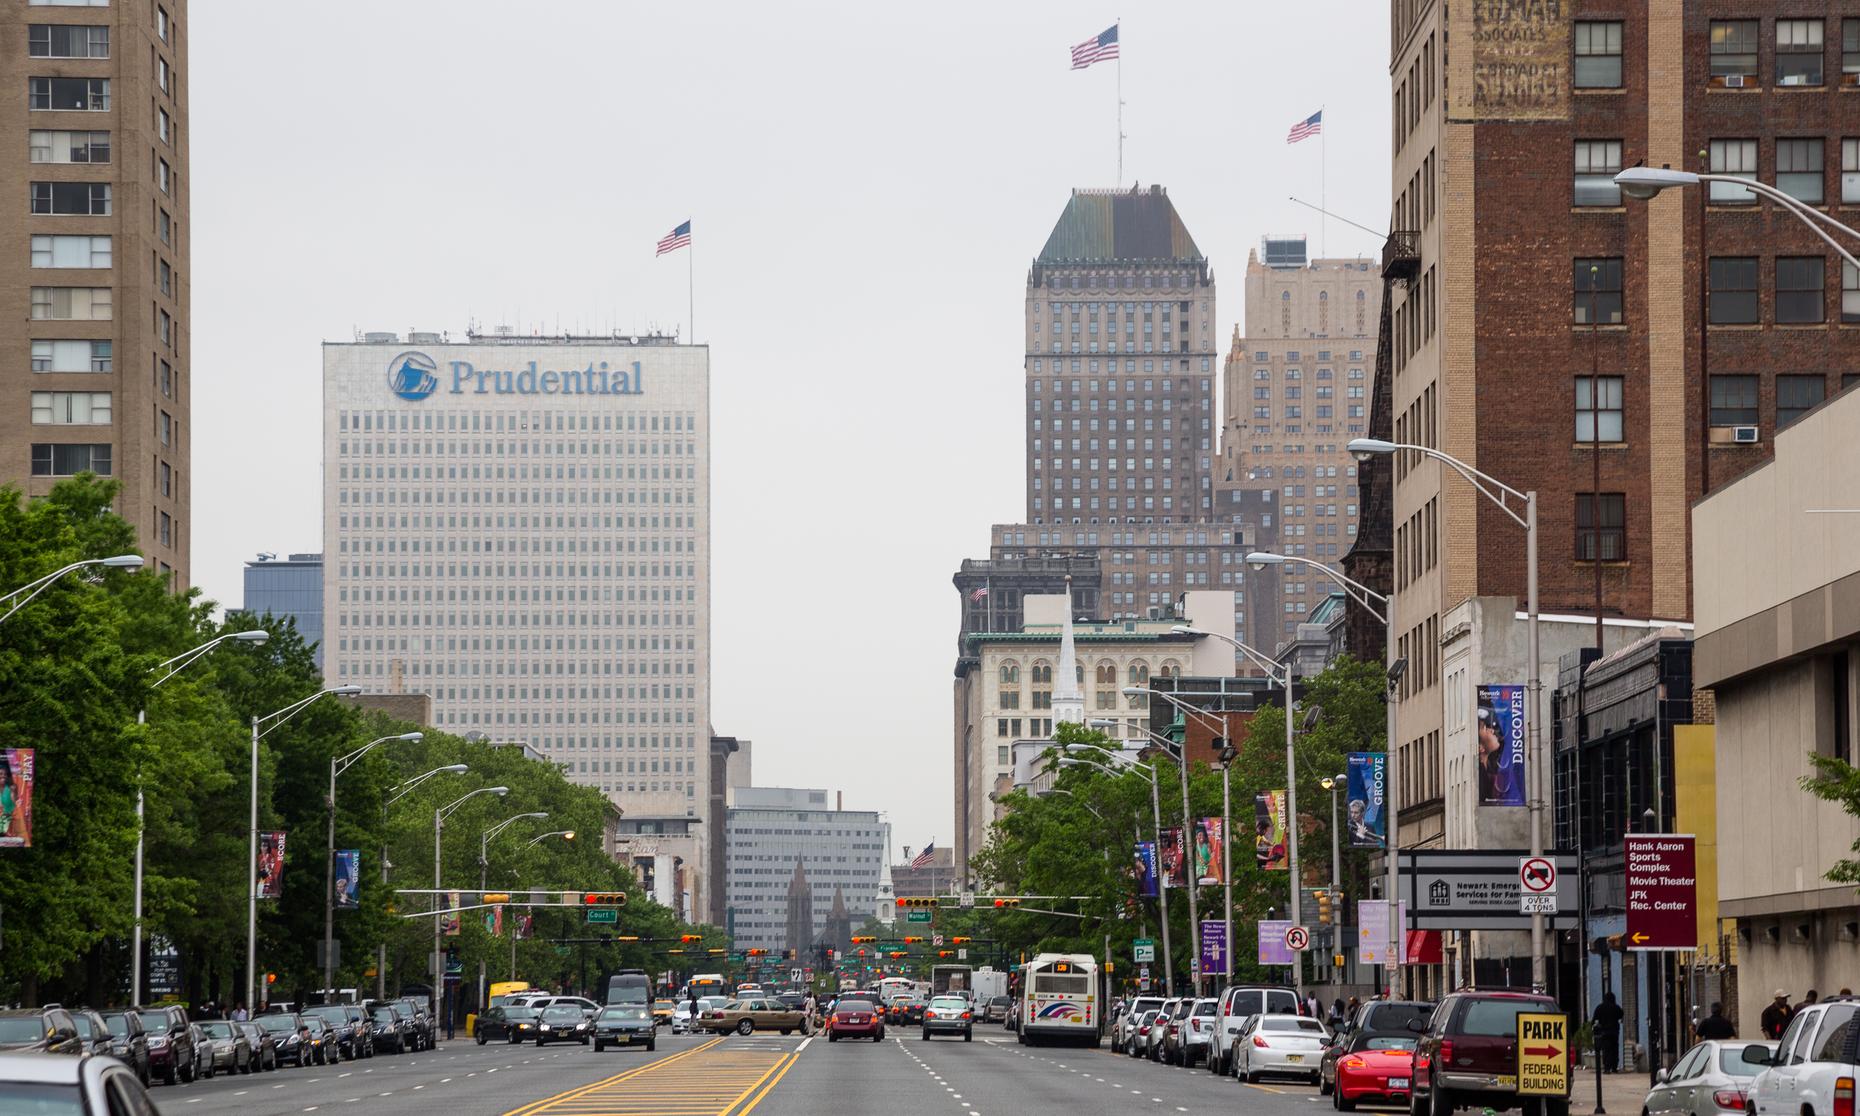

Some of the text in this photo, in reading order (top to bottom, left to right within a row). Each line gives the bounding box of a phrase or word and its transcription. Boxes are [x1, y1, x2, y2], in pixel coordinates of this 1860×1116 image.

[449, 361, 644, 395] Prudential
[1511, 691, 1523, 764] DISCOVER
[23, 754, 33, 781] PLAY
[1374, 758, 1384, 806] GROOVE
[1278, 795, 1286, 831] CREATE
[277, 833, 286, 861] SCORE
[1176, 829, 1184, 854] SCORE
[1629, 842, 1684, 851] Hank Aaron
[1149, 843, 1157, 878] DISCOVER
[1629, 852, 1661, 862] Sports
[352, 852, 360, 883] GROOVE
[1629, 863, 1671, 873] Complex
[1630, 877, 1695, 886] Movie Theater
[1630, 891, 1647, 899] JFK
[1630, 901, 1687, 910] Rec. Center
[1136, 949, 1145, 959] P
[1523, 1021, 1564, 1040] PARK
[1523, 1064, 1563, 1075] FEDERAL
[1523, 1078, 1564, 1089] BUILDING
